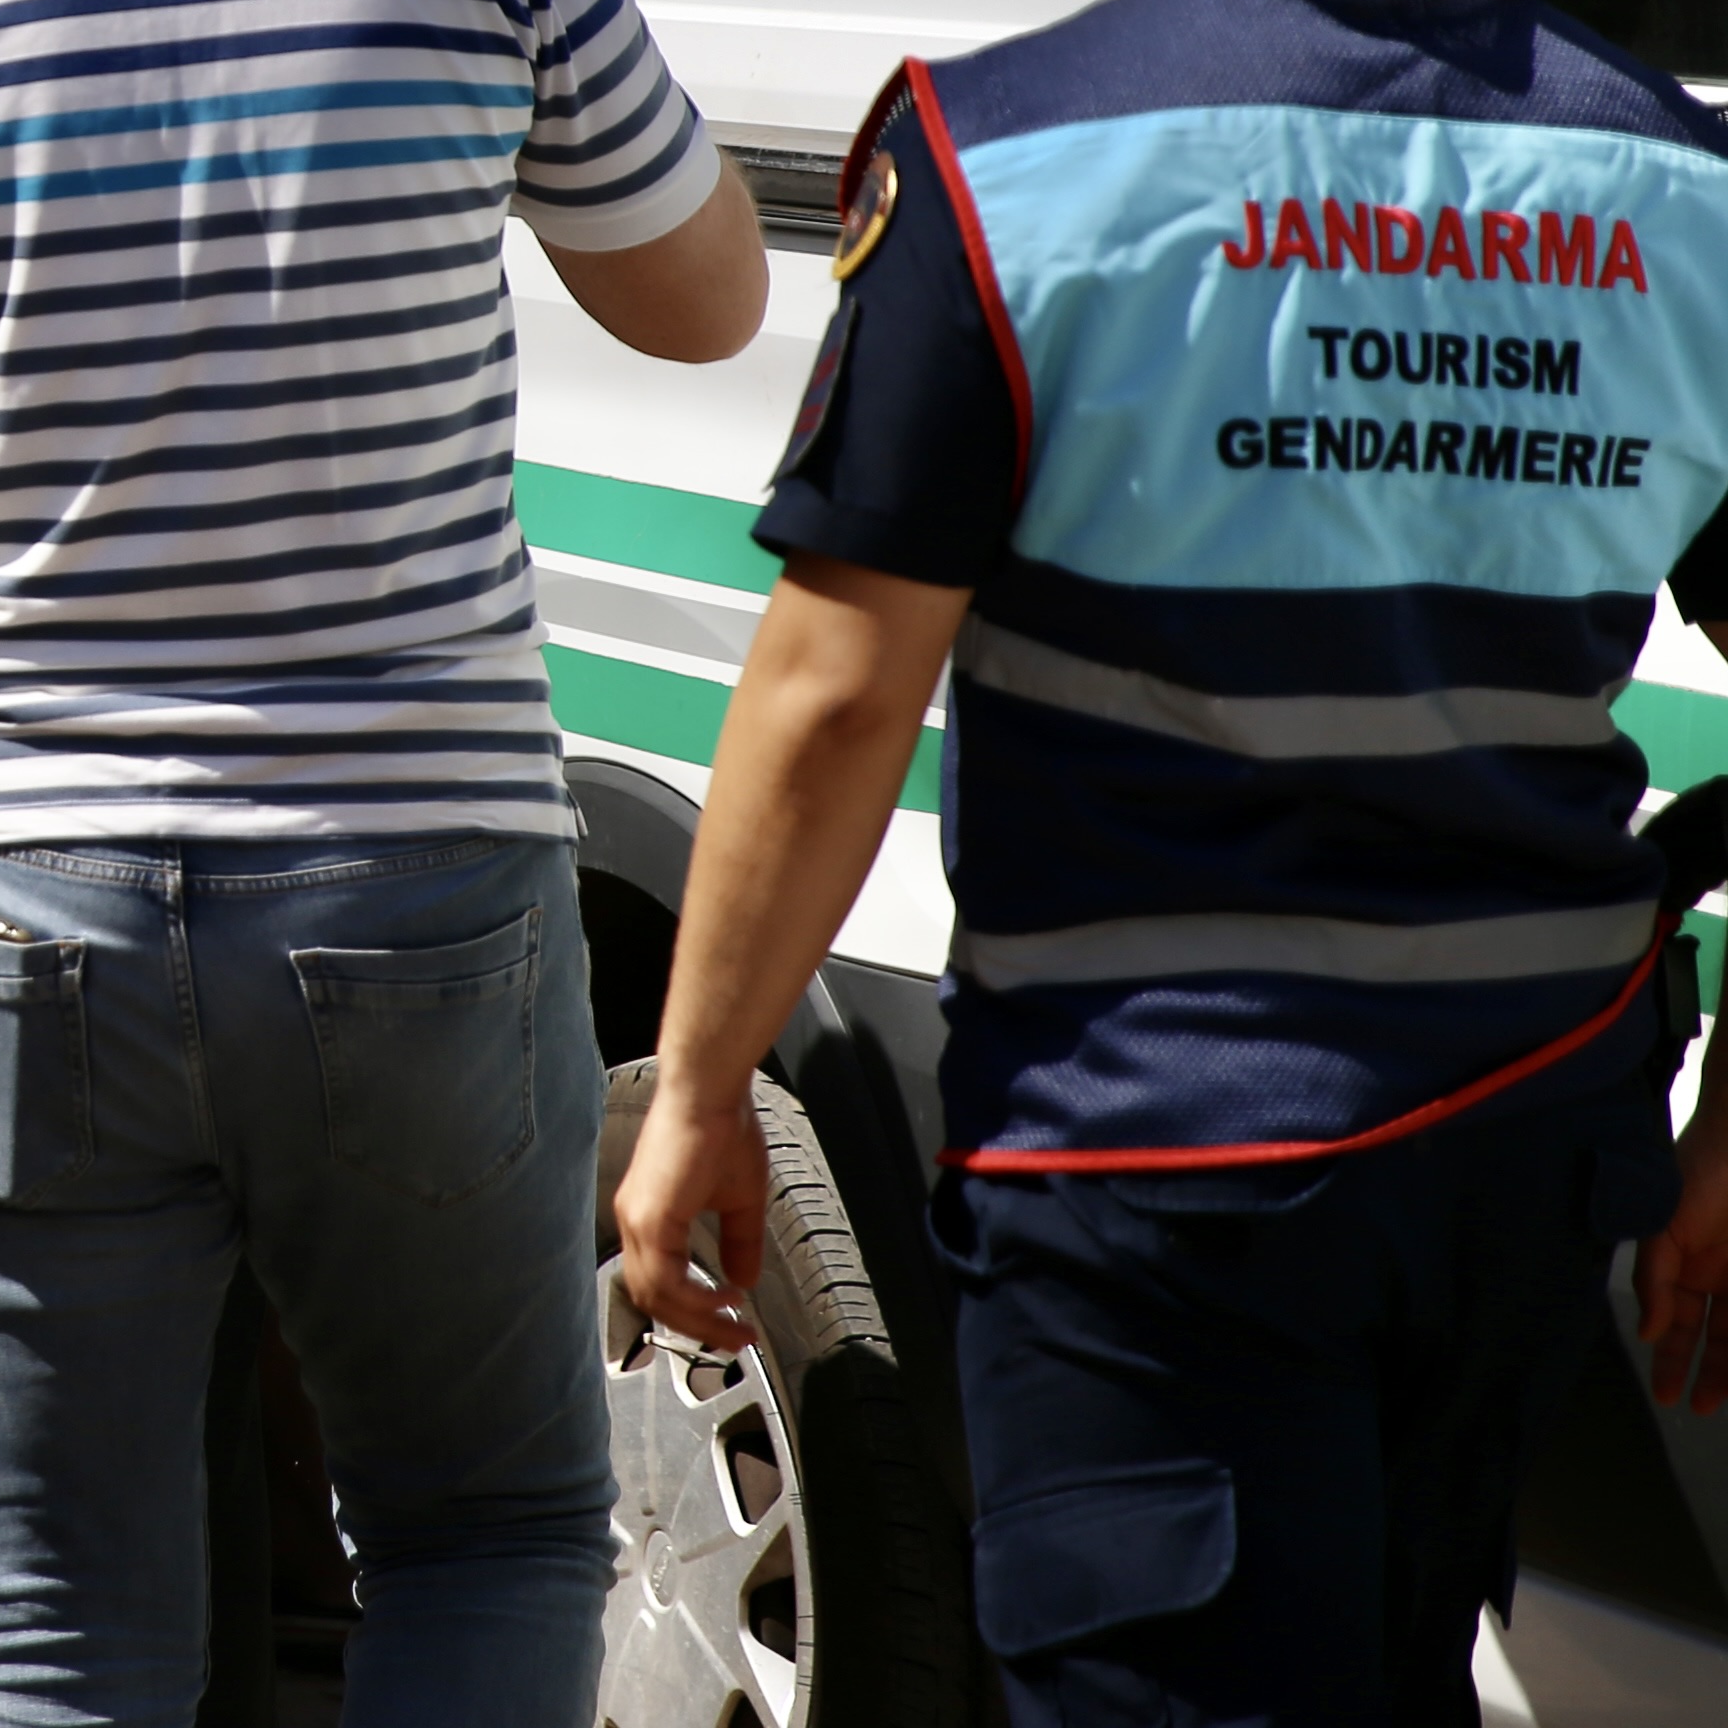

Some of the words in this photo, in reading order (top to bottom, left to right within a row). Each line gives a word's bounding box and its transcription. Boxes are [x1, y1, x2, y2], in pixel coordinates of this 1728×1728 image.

[1220, 196, 1650, 294] JANDARMA
[1307, 325, 1582, 396] TOURISM
[1216, 415, 1651, 488] GENDARMERIE
